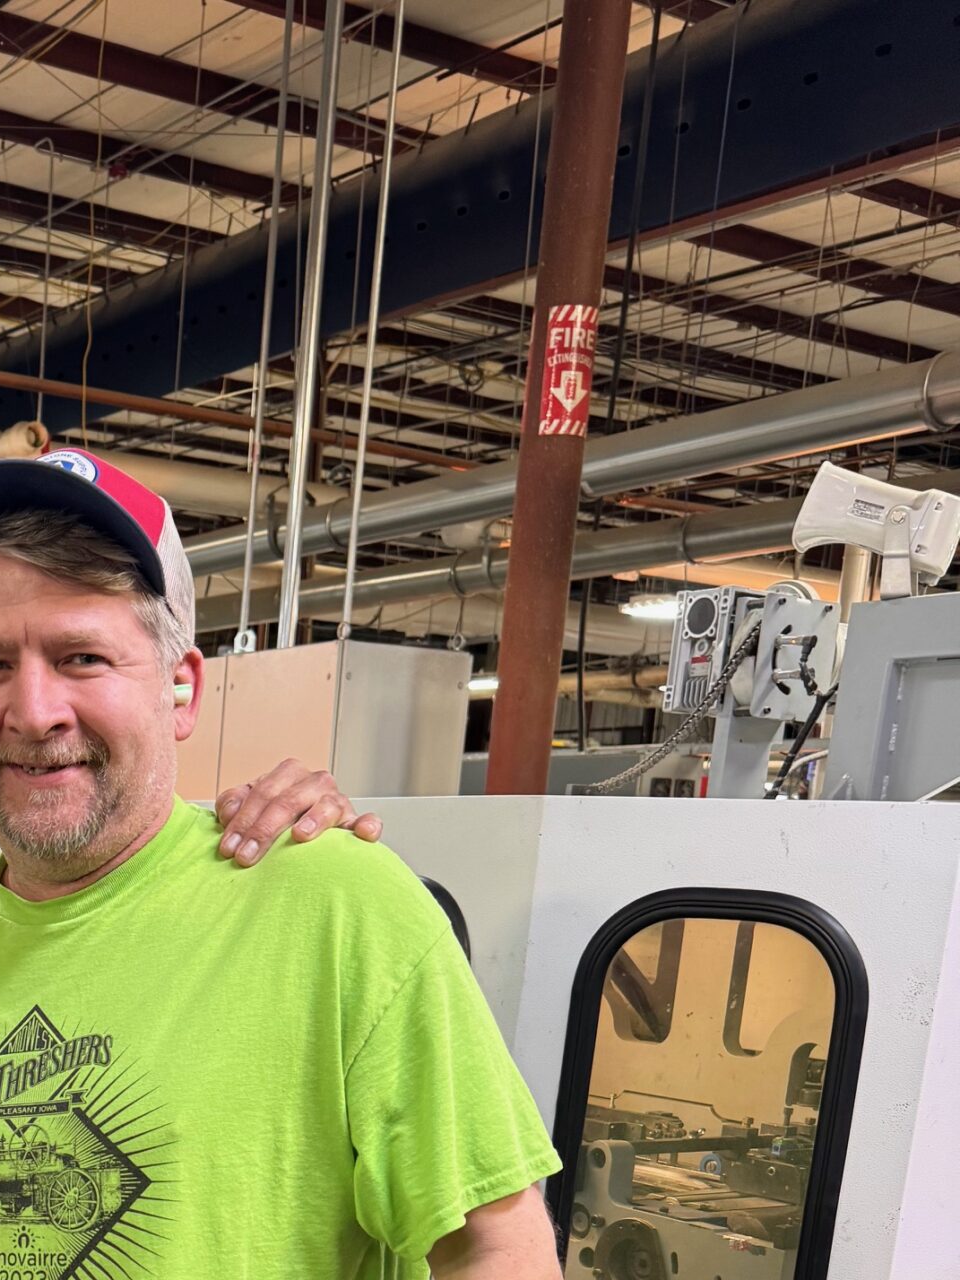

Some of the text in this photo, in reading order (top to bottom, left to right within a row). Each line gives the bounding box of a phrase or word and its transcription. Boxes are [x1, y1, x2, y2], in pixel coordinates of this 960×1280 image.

[549, 327, 596, 351] FIRE
[7, 1016, 54, 1053] MIDWEST
[38, 1104, 58, 1113] IOWA
